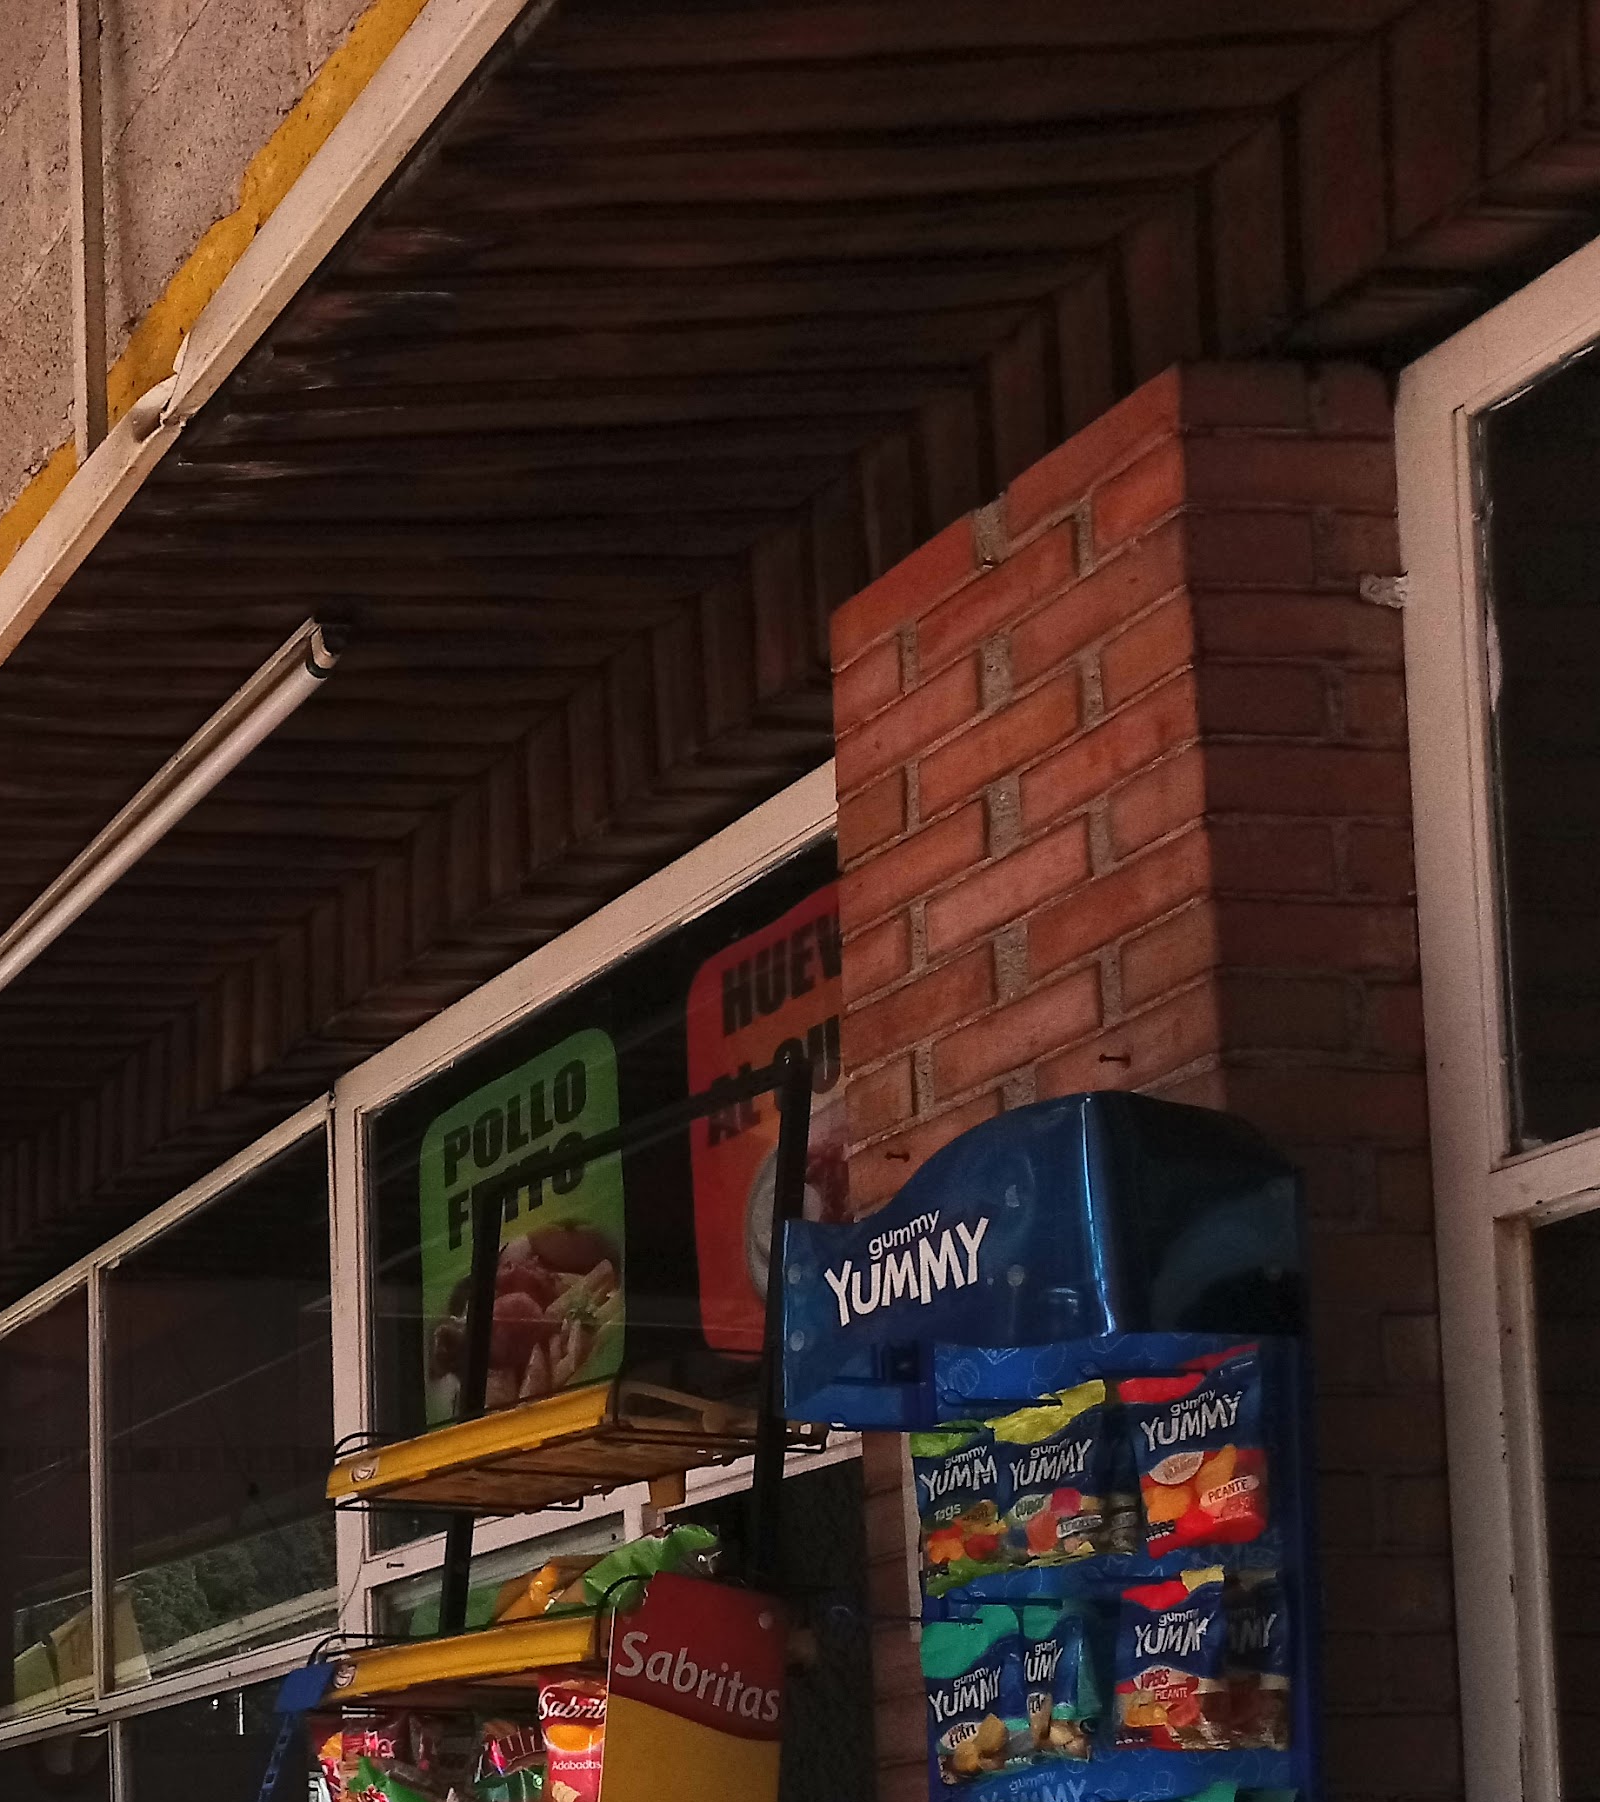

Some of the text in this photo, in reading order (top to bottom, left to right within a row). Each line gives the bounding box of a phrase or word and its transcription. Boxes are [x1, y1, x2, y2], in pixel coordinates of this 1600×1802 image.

[443, 1058, 587, 1189] POLLO
[868, 1210, 940, 1261] gummy
[824, 1216, 990, 1328] YUMMY
[1139, 1389, 1245, 1453] YUMMY
[1170, 1388, 1217, 1418] gummy
[918, 1457, 998, 1502] YUMM
[944, 1443, 989, 1471] gummy
[1008, 1438, 1094, 1493] YUMMY
[1206, 1477, 1251, 1503] PICANTE
[614, 1630, 781, 1725] Sabritas
[927, 1668, 1002, 1724] YUMMY
[952, 1667, 990, 1692] gummy
[538, 1691, 607, 1721] Sabrit
